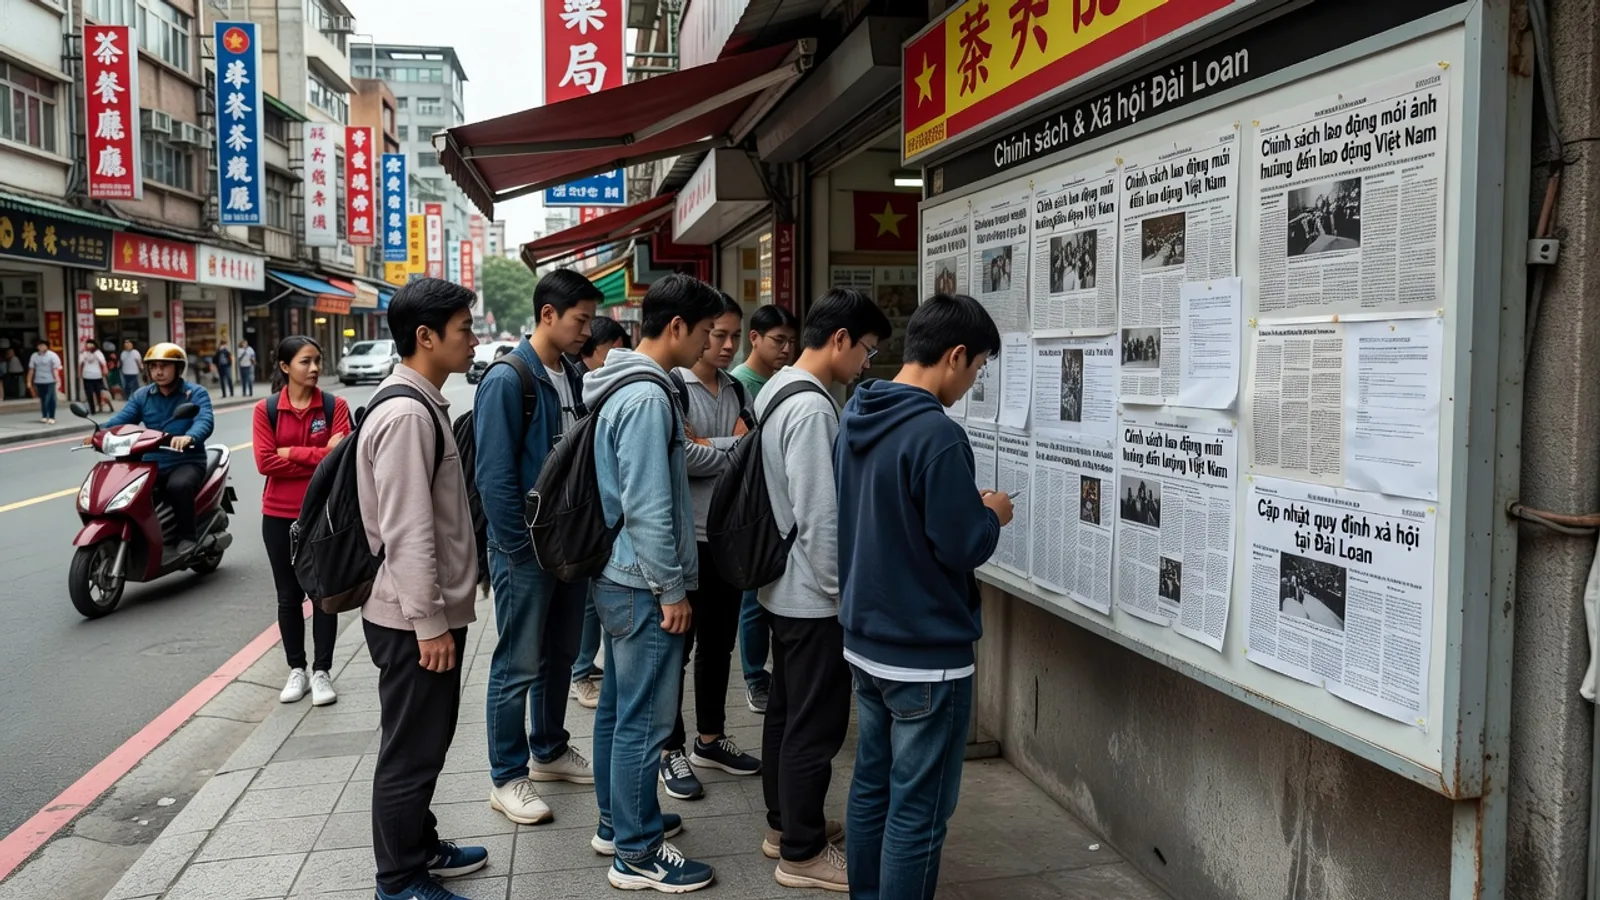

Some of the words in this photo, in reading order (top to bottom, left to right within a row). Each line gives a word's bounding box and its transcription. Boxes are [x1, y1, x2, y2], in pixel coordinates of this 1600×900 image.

[994, 133, 1030, 167] Chính
[1034, 115, 1068, 152] sách
[1073, 109, 1085, 138] &
[1090, 94, 1111, 132] Xã
[1117, 82, 1145, 123] hội
[1150, 66, 1184, 108] Đài
[1193, 48, 1249, 93] Loan
[1405, 125, 1437, 147] Nam
[1314, 514, 1337, 534] quy
[1396, 523, 1420, 551] hội
[1339, 538, 1373, 564] Loan
